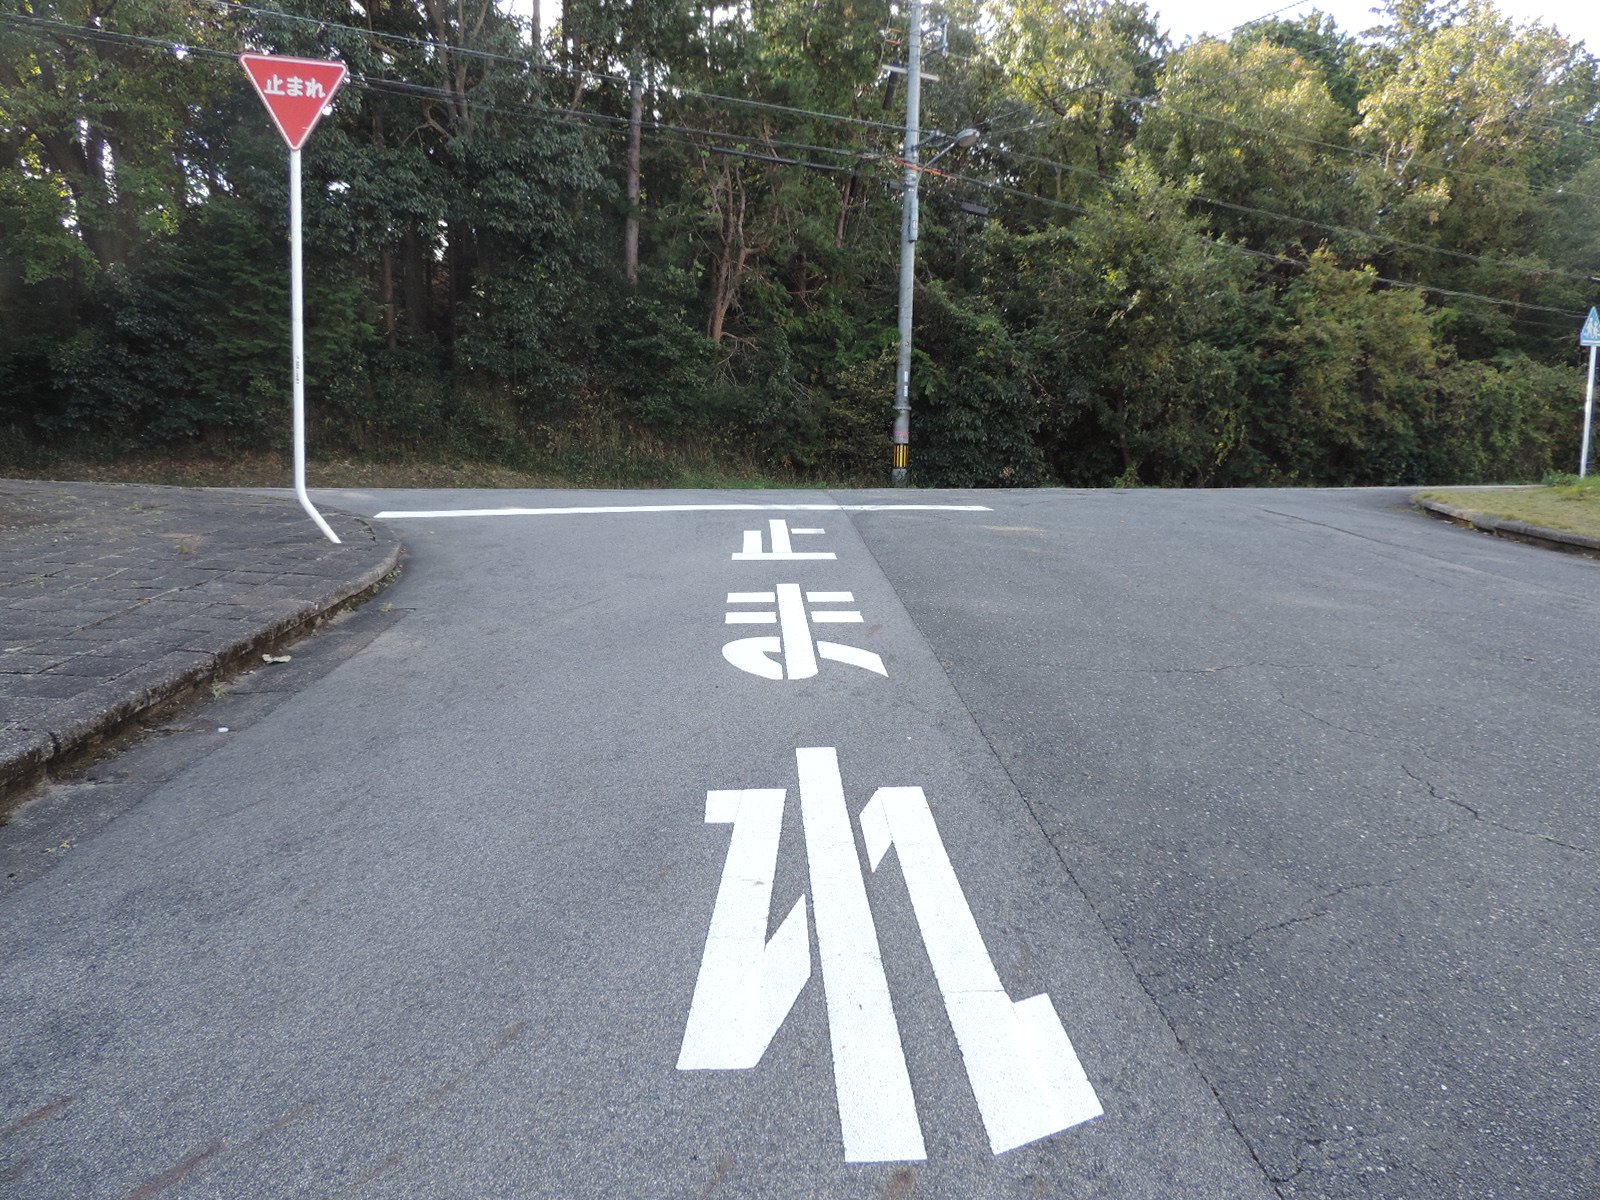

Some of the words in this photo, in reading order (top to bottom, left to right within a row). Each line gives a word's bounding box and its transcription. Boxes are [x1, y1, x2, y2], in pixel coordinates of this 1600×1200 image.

[264, 74, 326, 98] 止まれ
[675, 518, 1105, 1164] 止まれ
